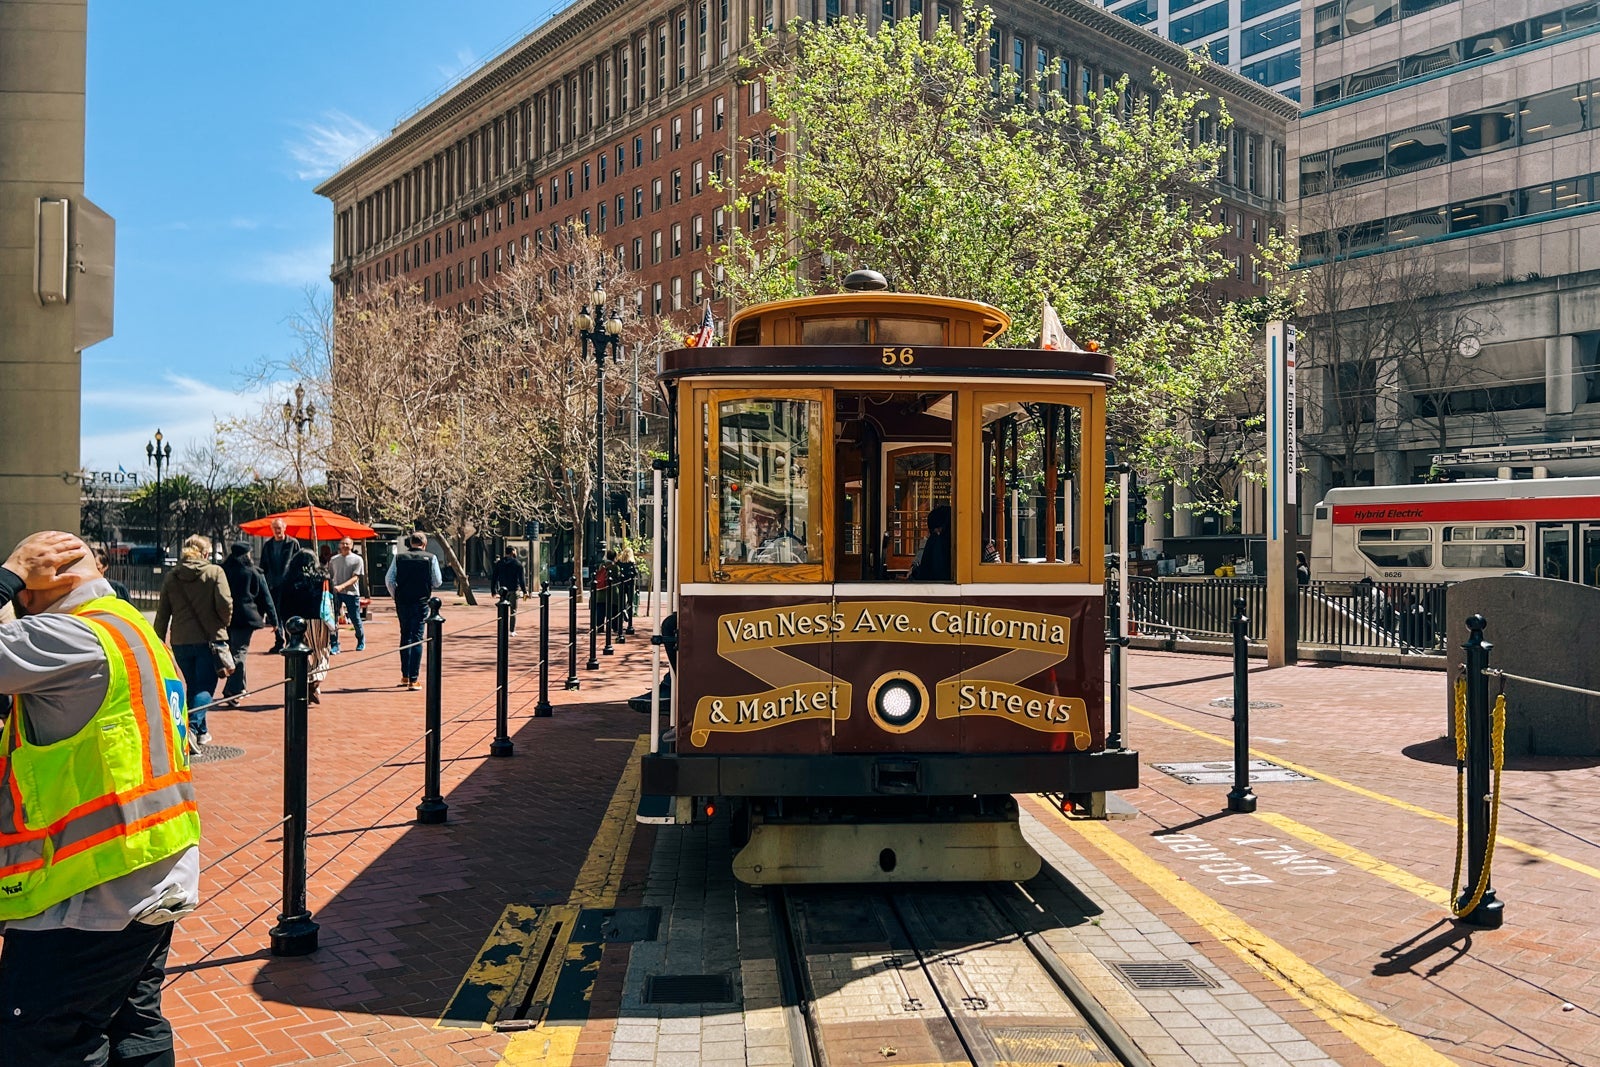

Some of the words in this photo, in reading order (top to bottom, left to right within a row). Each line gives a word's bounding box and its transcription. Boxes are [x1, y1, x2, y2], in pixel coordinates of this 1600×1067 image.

[882, 347, 914, 365] 56
[1287, 392, 1295, 474] Embarcadero
[1354, 509, 1386, 520] Hybrid
[1388, 508, 1424, 518] Electric
[725, 617, 773, 643] Van
[777, 611, 846, 638] Ness
[930, 610, 1065, 644] California
[710, 699, 730, 724] &
[736, 686, 838, 724] Market
[958, 685, 1072, 723] Streets
[1154, 833, 1275, 885] BOARD
[1228, 837, 1338, 876] ONLY
